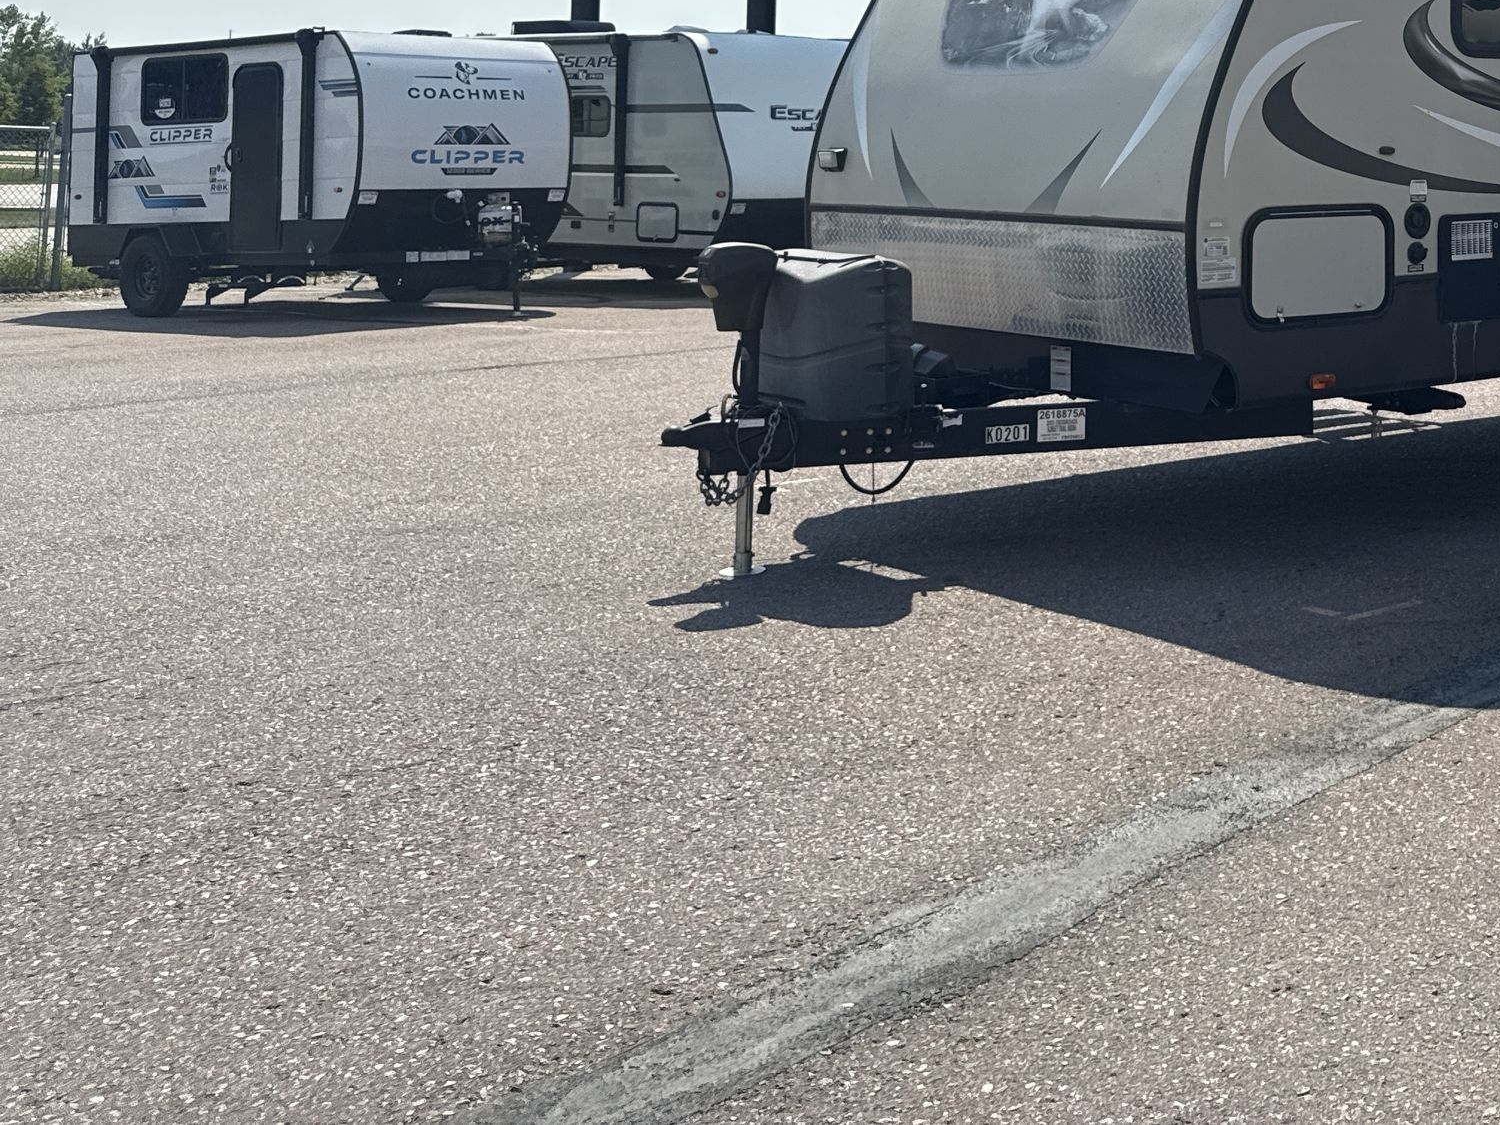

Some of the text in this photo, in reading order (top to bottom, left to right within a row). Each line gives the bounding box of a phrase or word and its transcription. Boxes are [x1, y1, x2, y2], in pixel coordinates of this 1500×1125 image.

[407, 87, 525, 100] COACHMEN
[150, 128, 213, 142] CLIPPER
[411, 149, 525, 164] CLIPPER
[986, 425, 1027, 442] K0201
